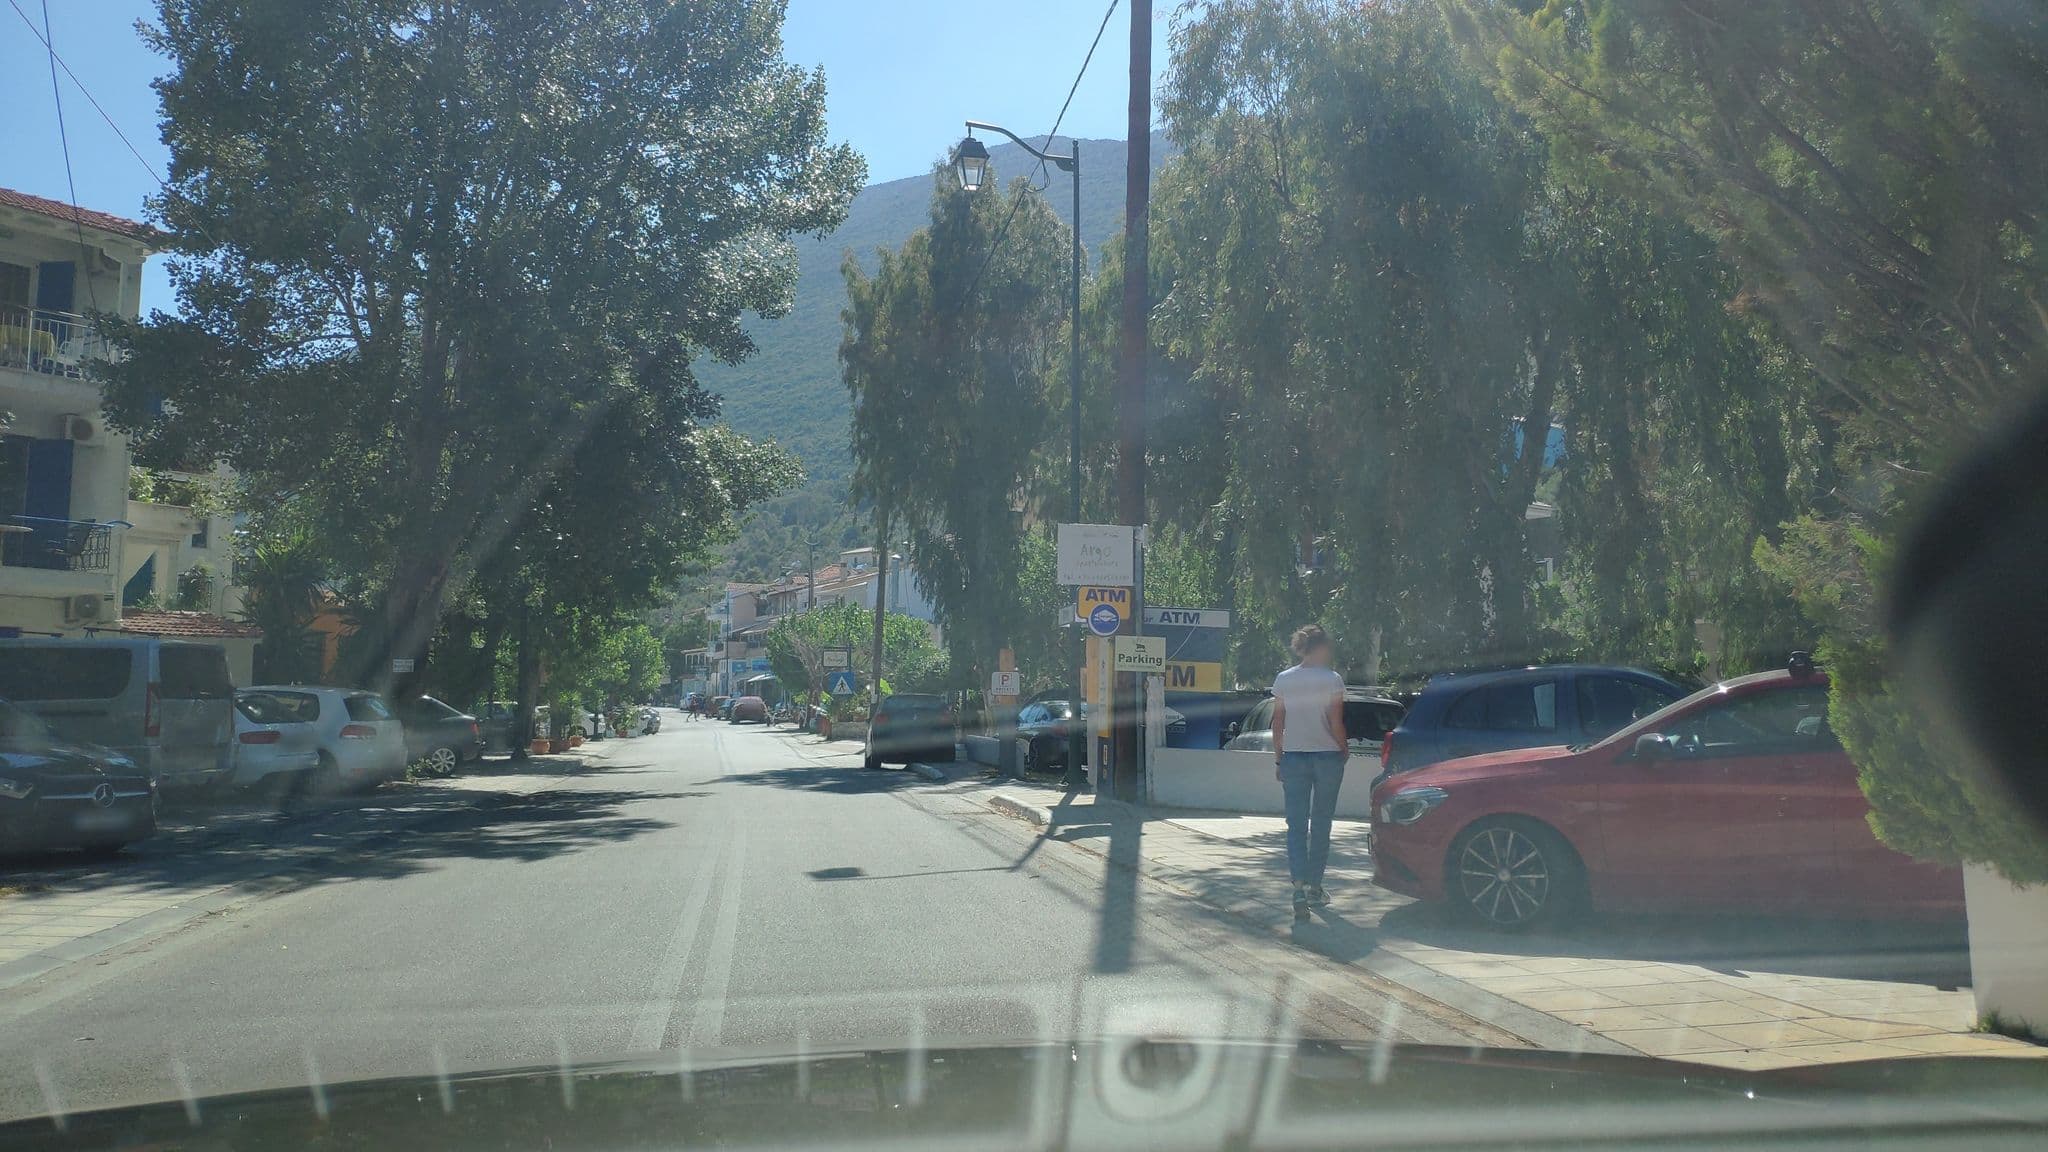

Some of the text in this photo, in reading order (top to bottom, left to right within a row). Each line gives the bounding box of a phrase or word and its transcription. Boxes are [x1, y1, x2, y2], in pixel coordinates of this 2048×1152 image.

[1085, 589, 1126, 602] ATM
[1160, 611, 1200, 625] ATM
[1118, 653, 1163, 667] Parking
[1164, 664, 1195, 688] TM
